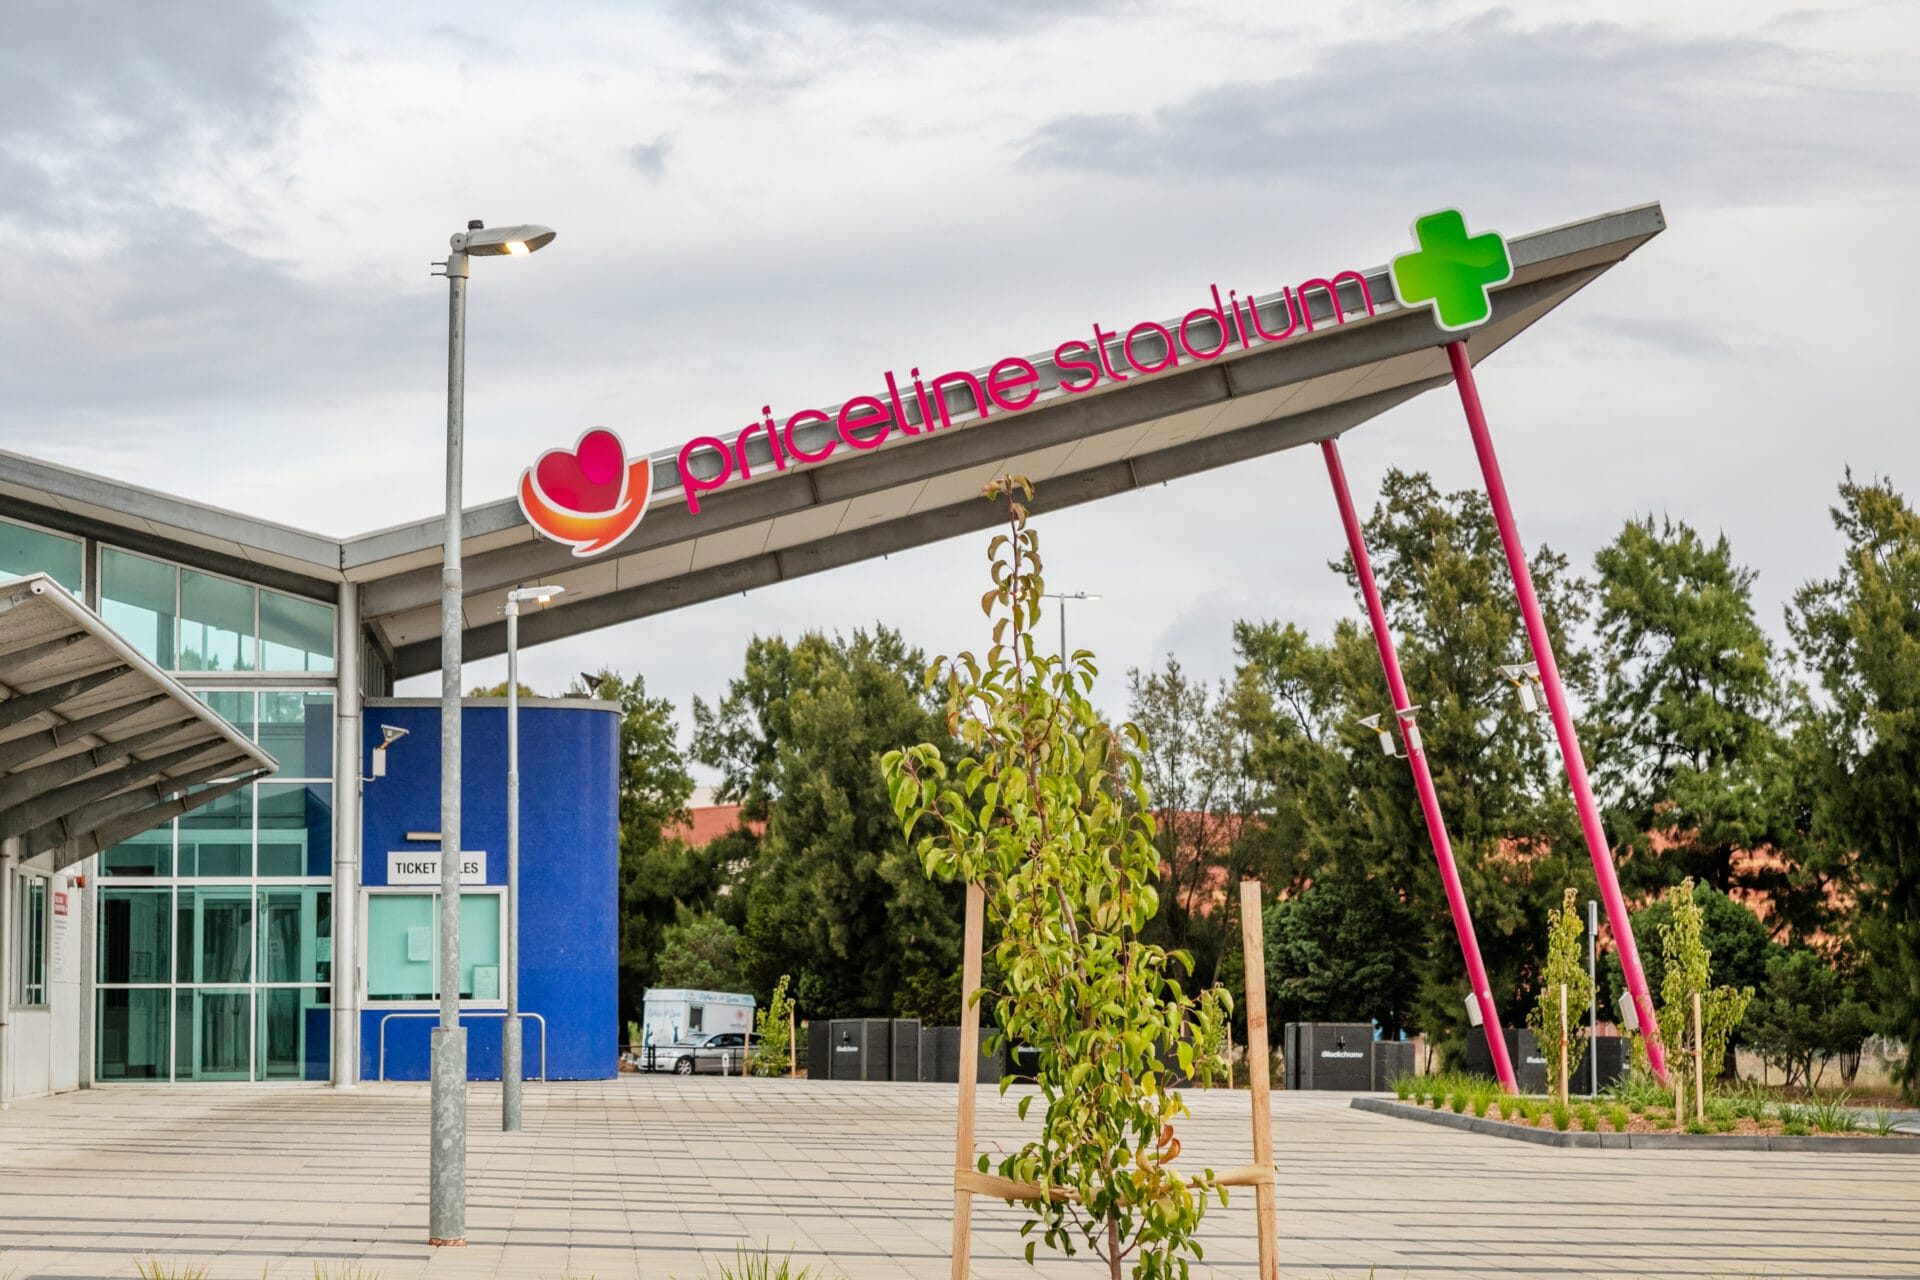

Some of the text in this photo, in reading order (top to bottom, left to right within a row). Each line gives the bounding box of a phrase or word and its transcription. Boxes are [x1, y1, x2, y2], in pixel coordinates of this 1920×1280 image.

[677, 270, 1376, 515] priceline stadium
[395, 862, 437, 874] TICKET
